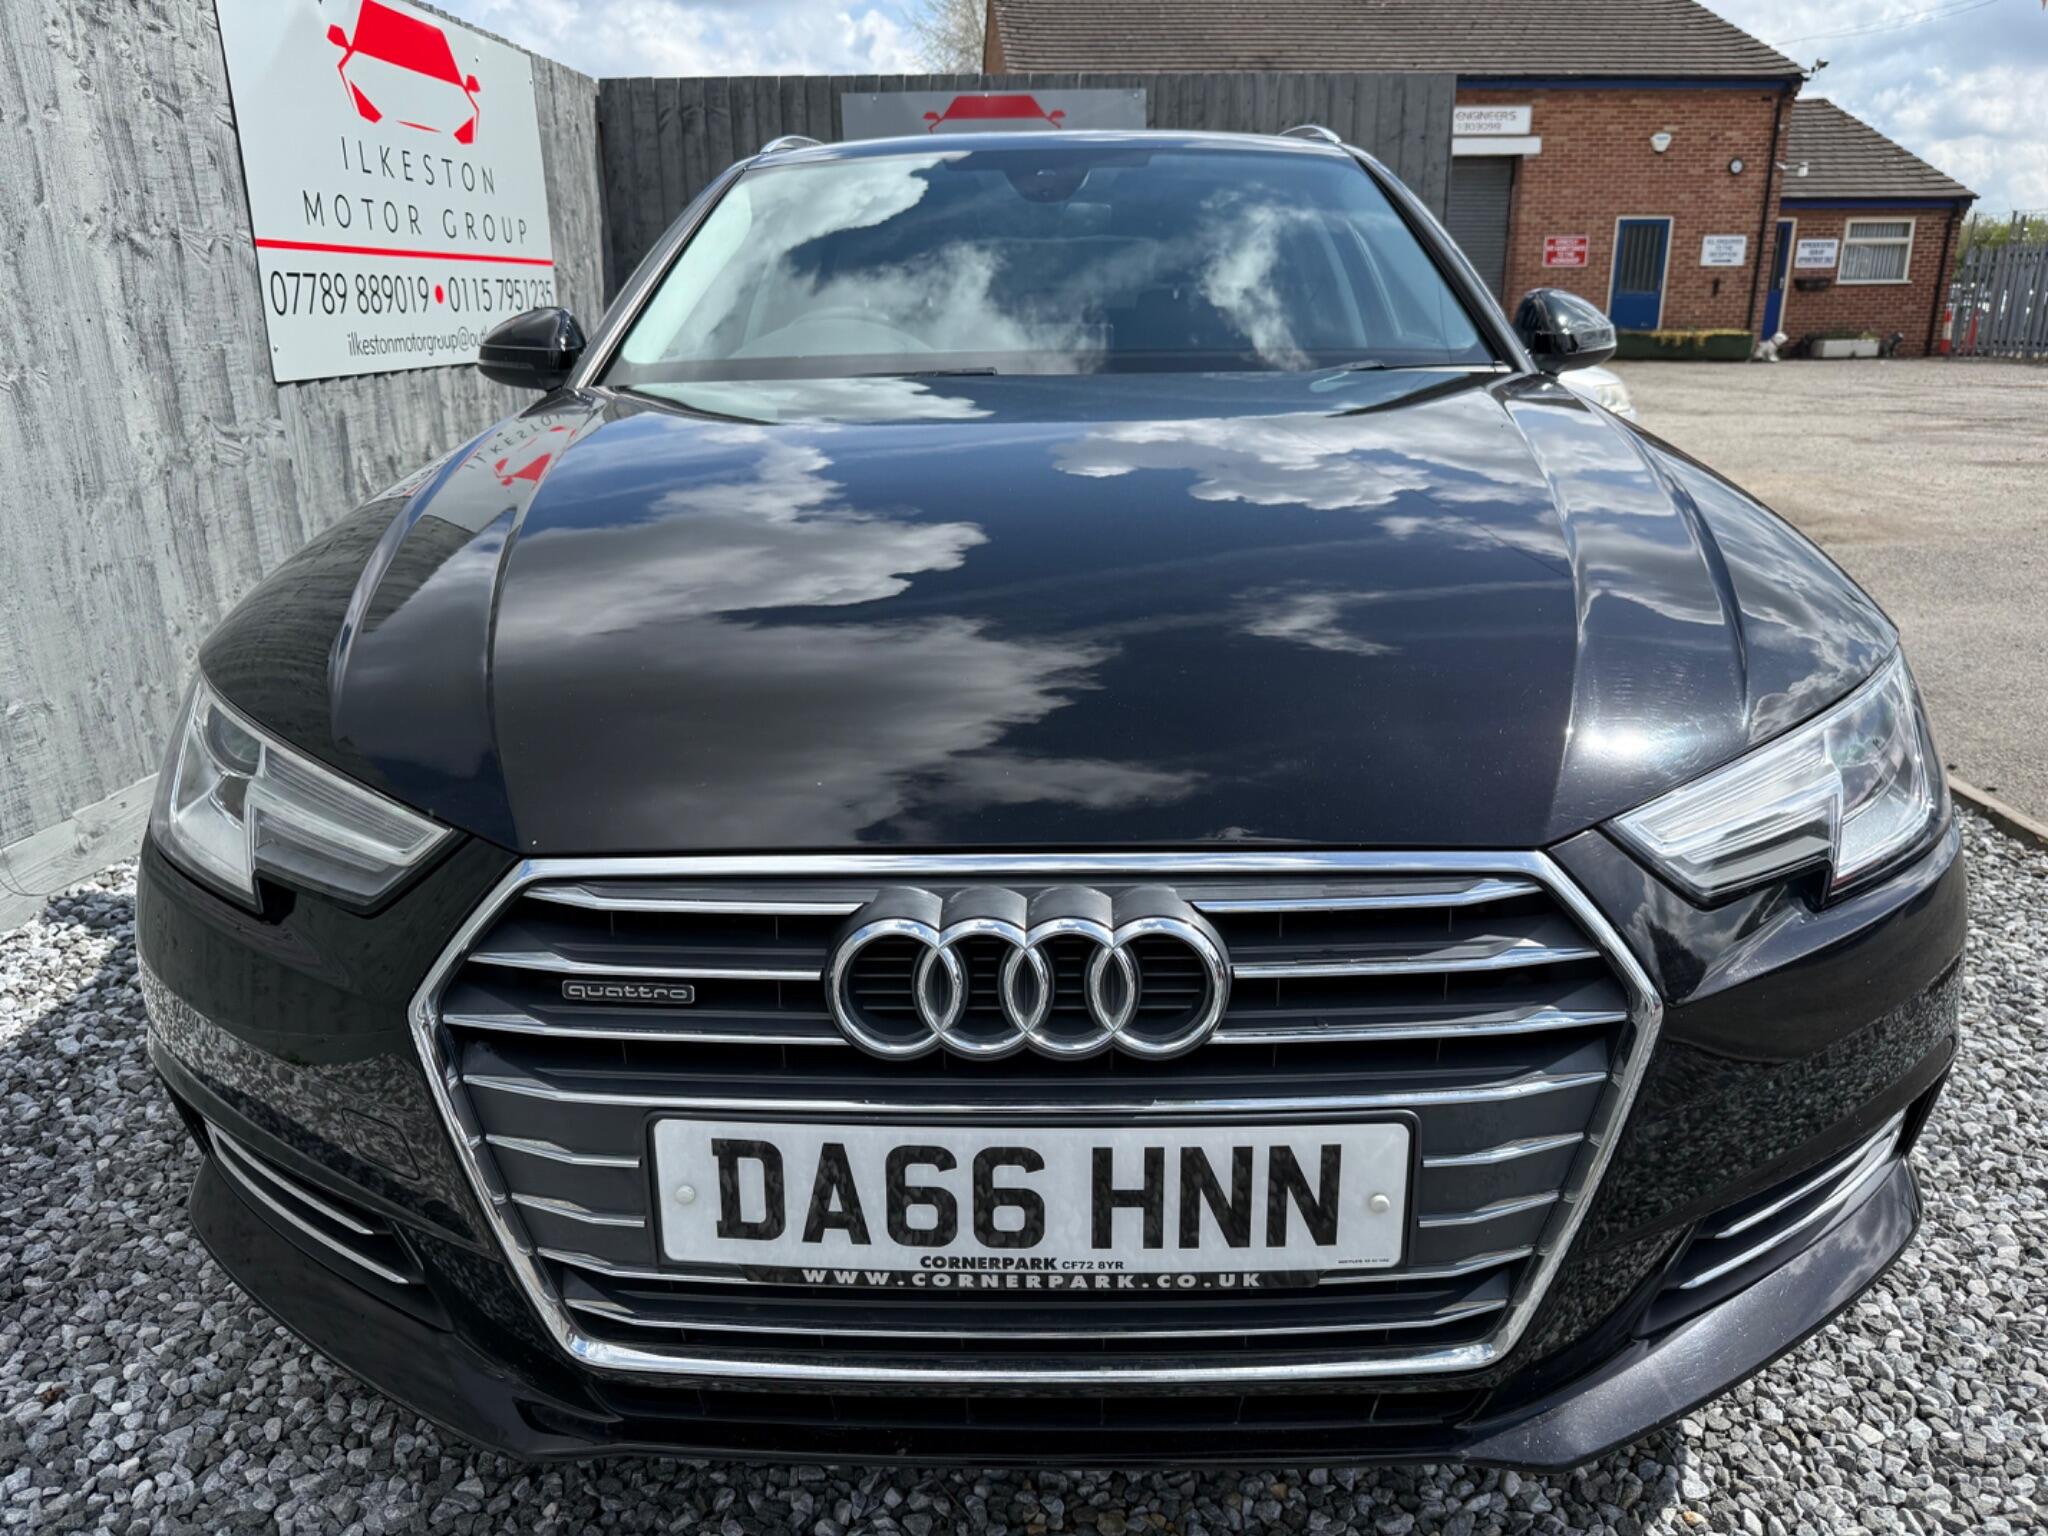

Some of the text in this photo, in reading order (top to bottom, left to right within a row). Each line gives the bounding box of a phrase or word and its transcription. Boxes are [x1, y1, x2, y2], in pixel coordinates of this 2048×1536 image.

[341, 135, 496, 195] ILKESTON
[302, 189, 528, 244] MOTOR GROUP
[269, 270, 554, 316] 07789 889019 0115 7951235
[568, 984, 688, 999] quattro
[710, 1137, 1342, 1249] DA66 HNN
[802, 1268, 1261, 1289] WWW.CORNERPARK.CO.UK
[919, 1255, 1124, 1271] CORNERPARK CF72 8YR
